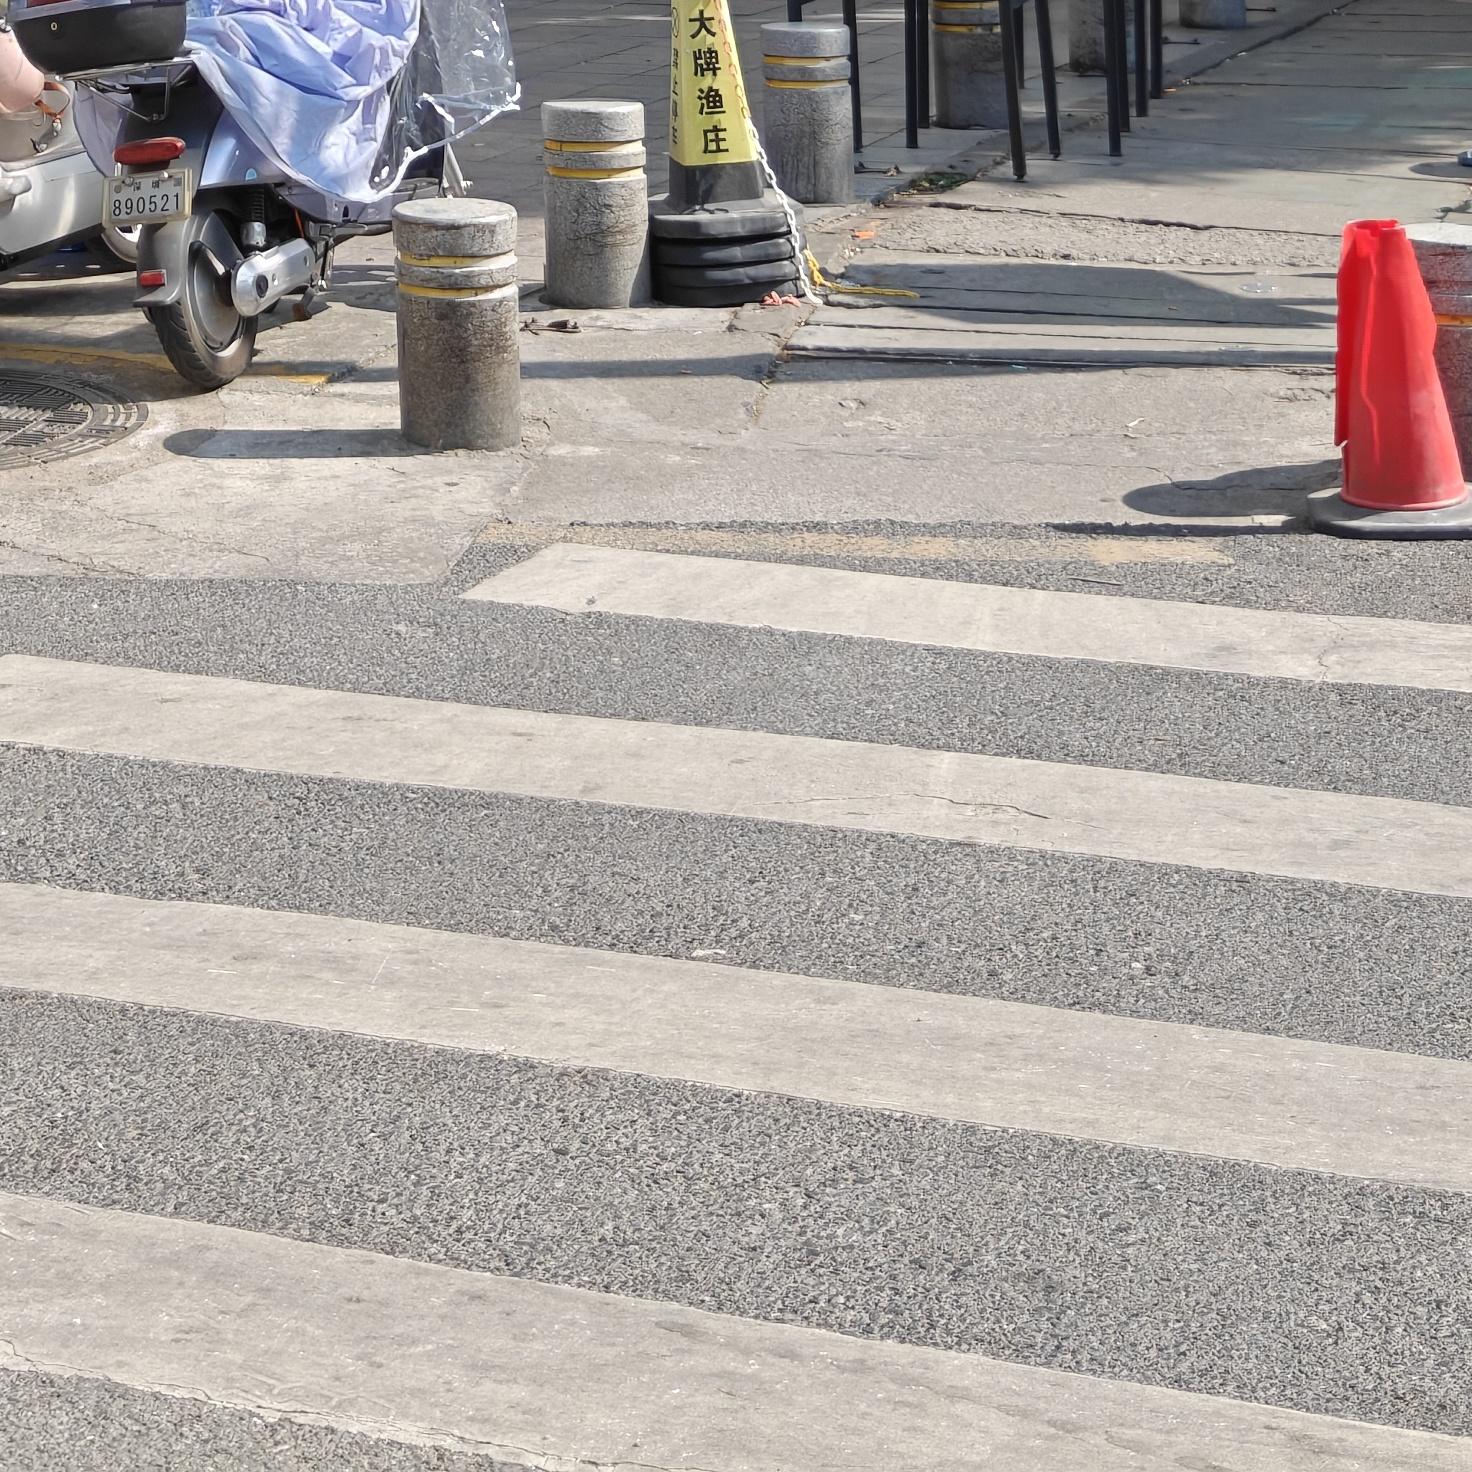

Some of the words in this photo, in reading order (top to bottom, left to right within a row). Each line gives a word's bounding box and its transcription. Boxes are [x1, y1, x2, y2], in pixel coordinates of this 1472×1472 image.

[688, 8, 730, 155] 大牌渔庄
[111, 191, 183, 219] 890521
